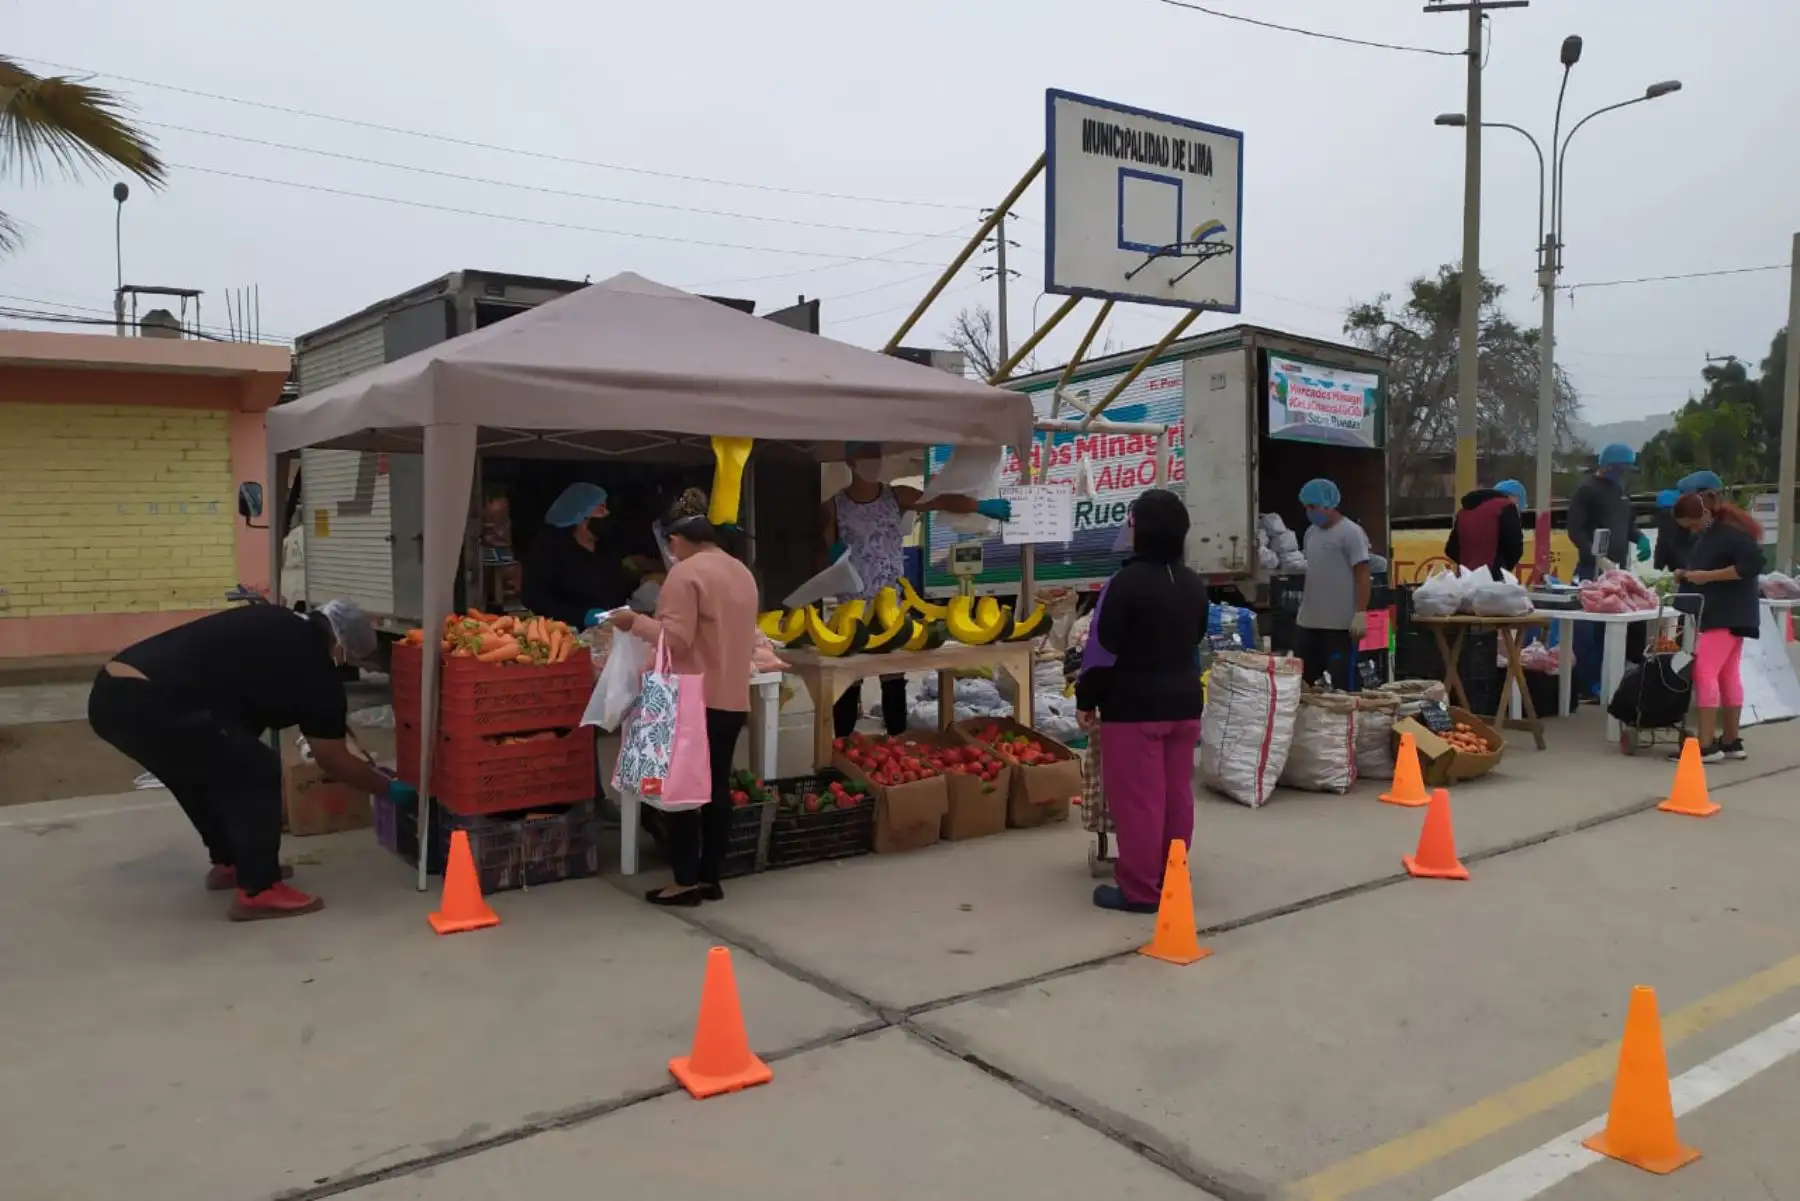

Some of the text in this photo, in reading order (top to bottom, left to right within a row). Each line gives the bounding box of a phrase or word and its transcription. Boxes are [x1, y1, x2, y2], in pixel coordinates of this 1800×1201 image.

[1083, 118, 1213, 177] MUNICIPALIDAD DE LIMA
